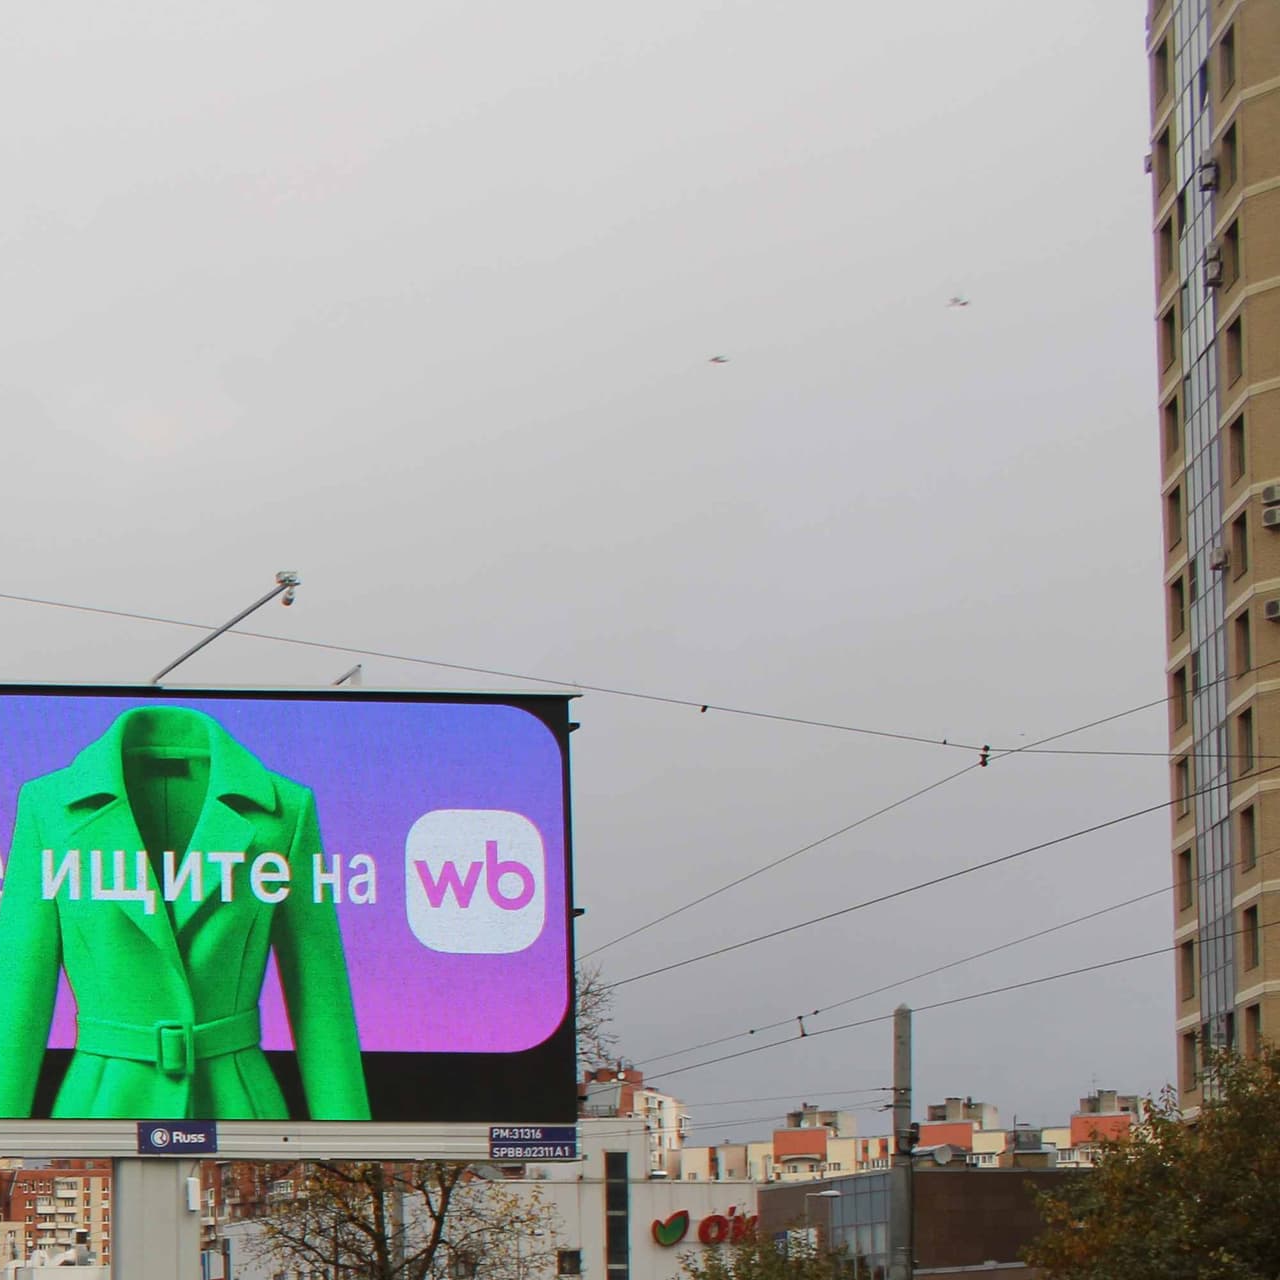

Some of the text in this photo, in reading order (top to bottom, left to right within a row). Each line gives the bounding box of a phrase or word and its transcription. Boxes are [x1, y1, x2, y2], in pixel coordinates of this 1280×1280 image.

[40, 847, 292, 914] ищите
[313, 850, 376, 905] на
[413, 840, 536, 911] wb
[173, 1132, 206, 1144] Russ
